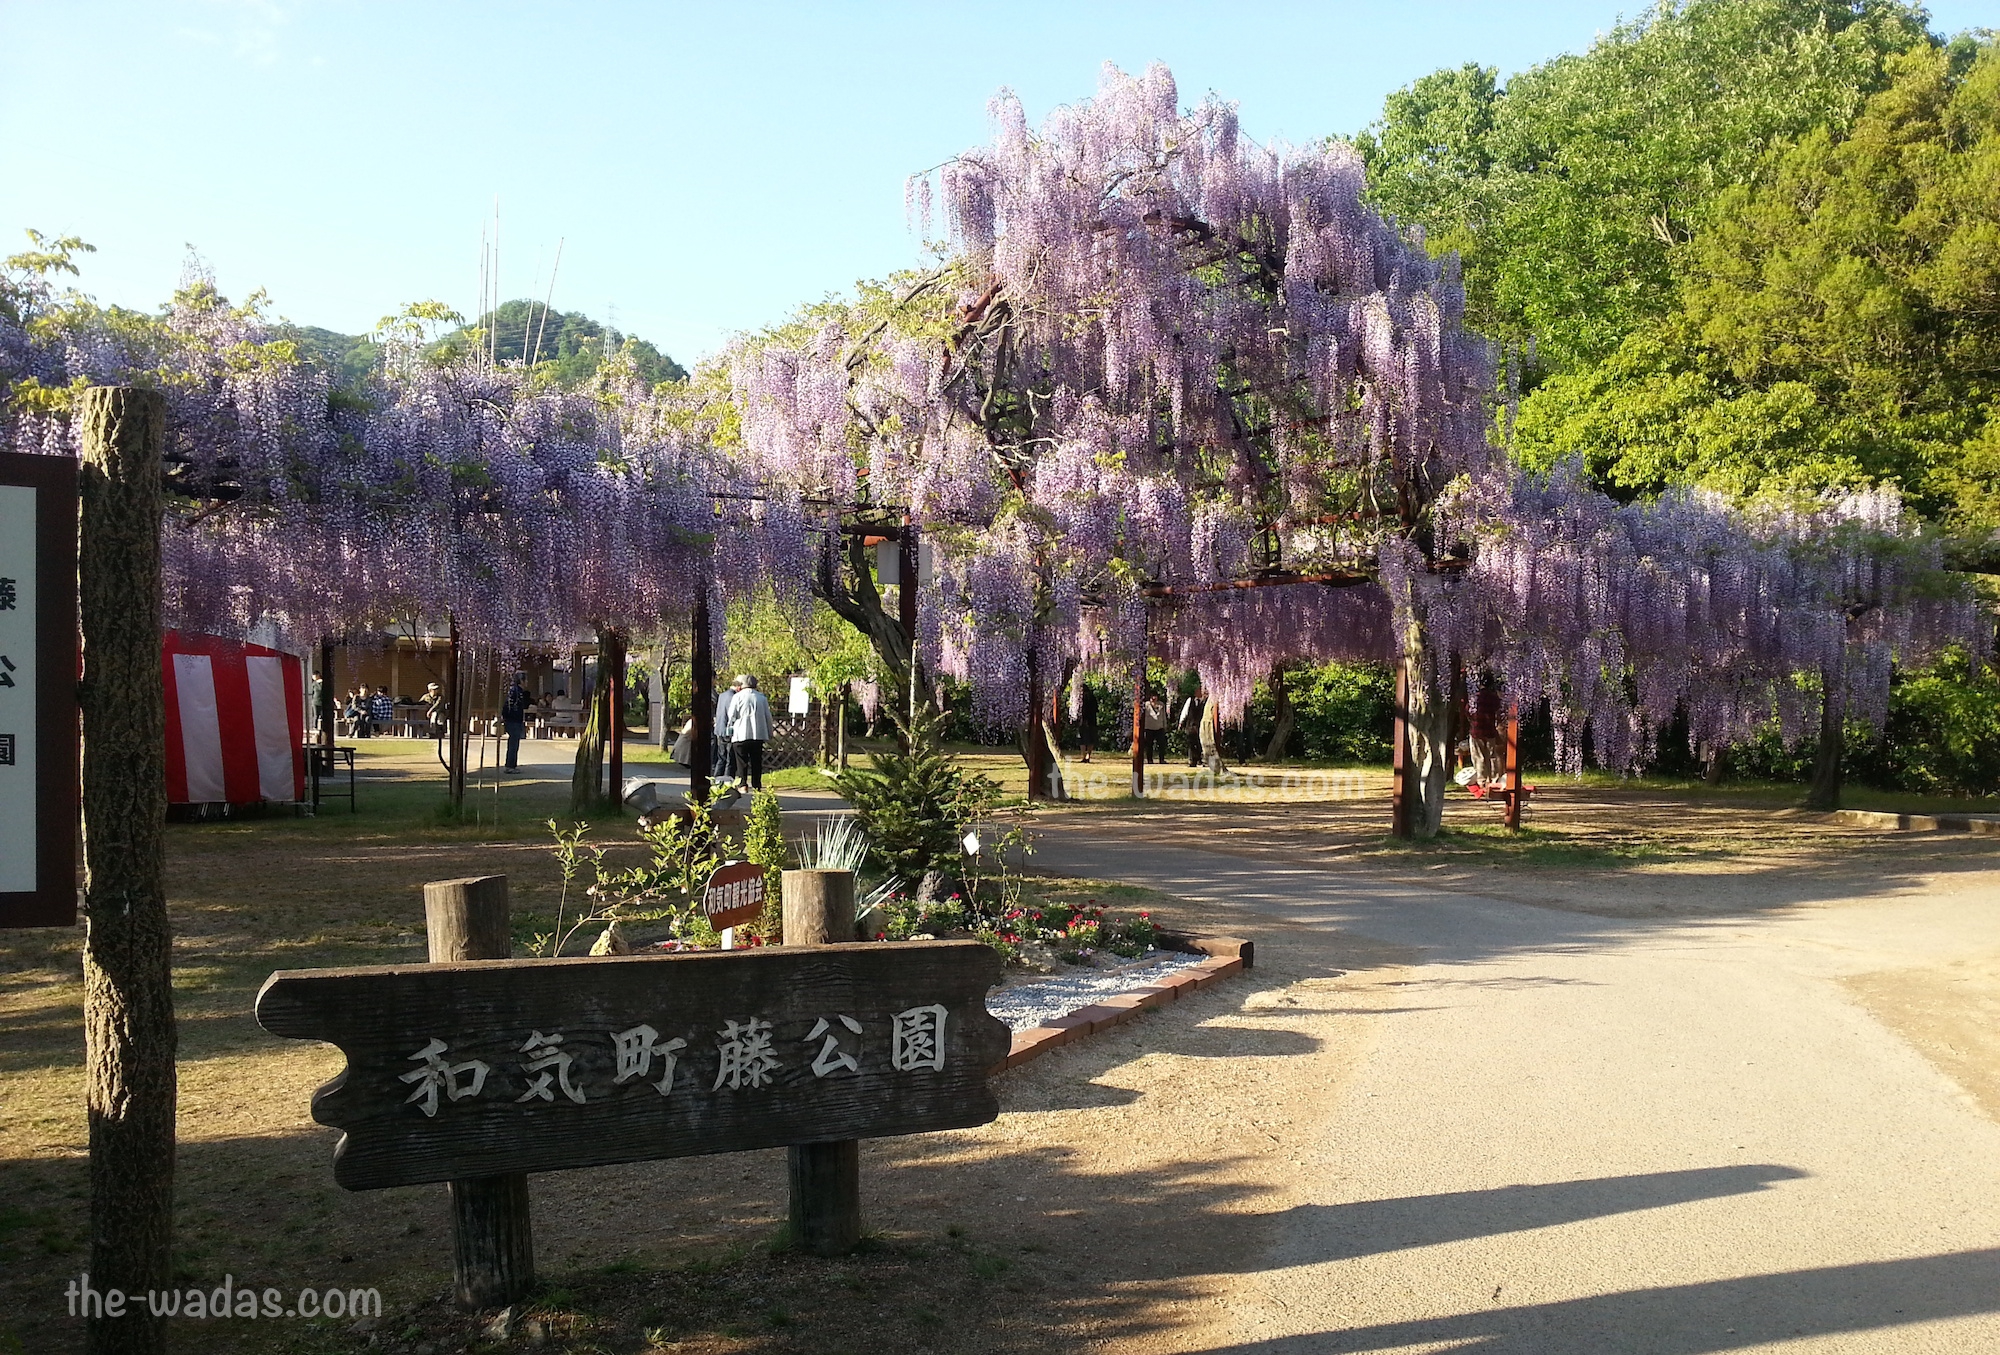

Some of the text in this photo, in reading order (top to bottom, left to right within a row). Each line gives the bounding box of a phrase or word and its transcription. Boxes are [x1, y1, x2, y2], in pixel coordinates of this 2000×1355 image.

[399, 1003, 949, 1117] 和気町藤公園
